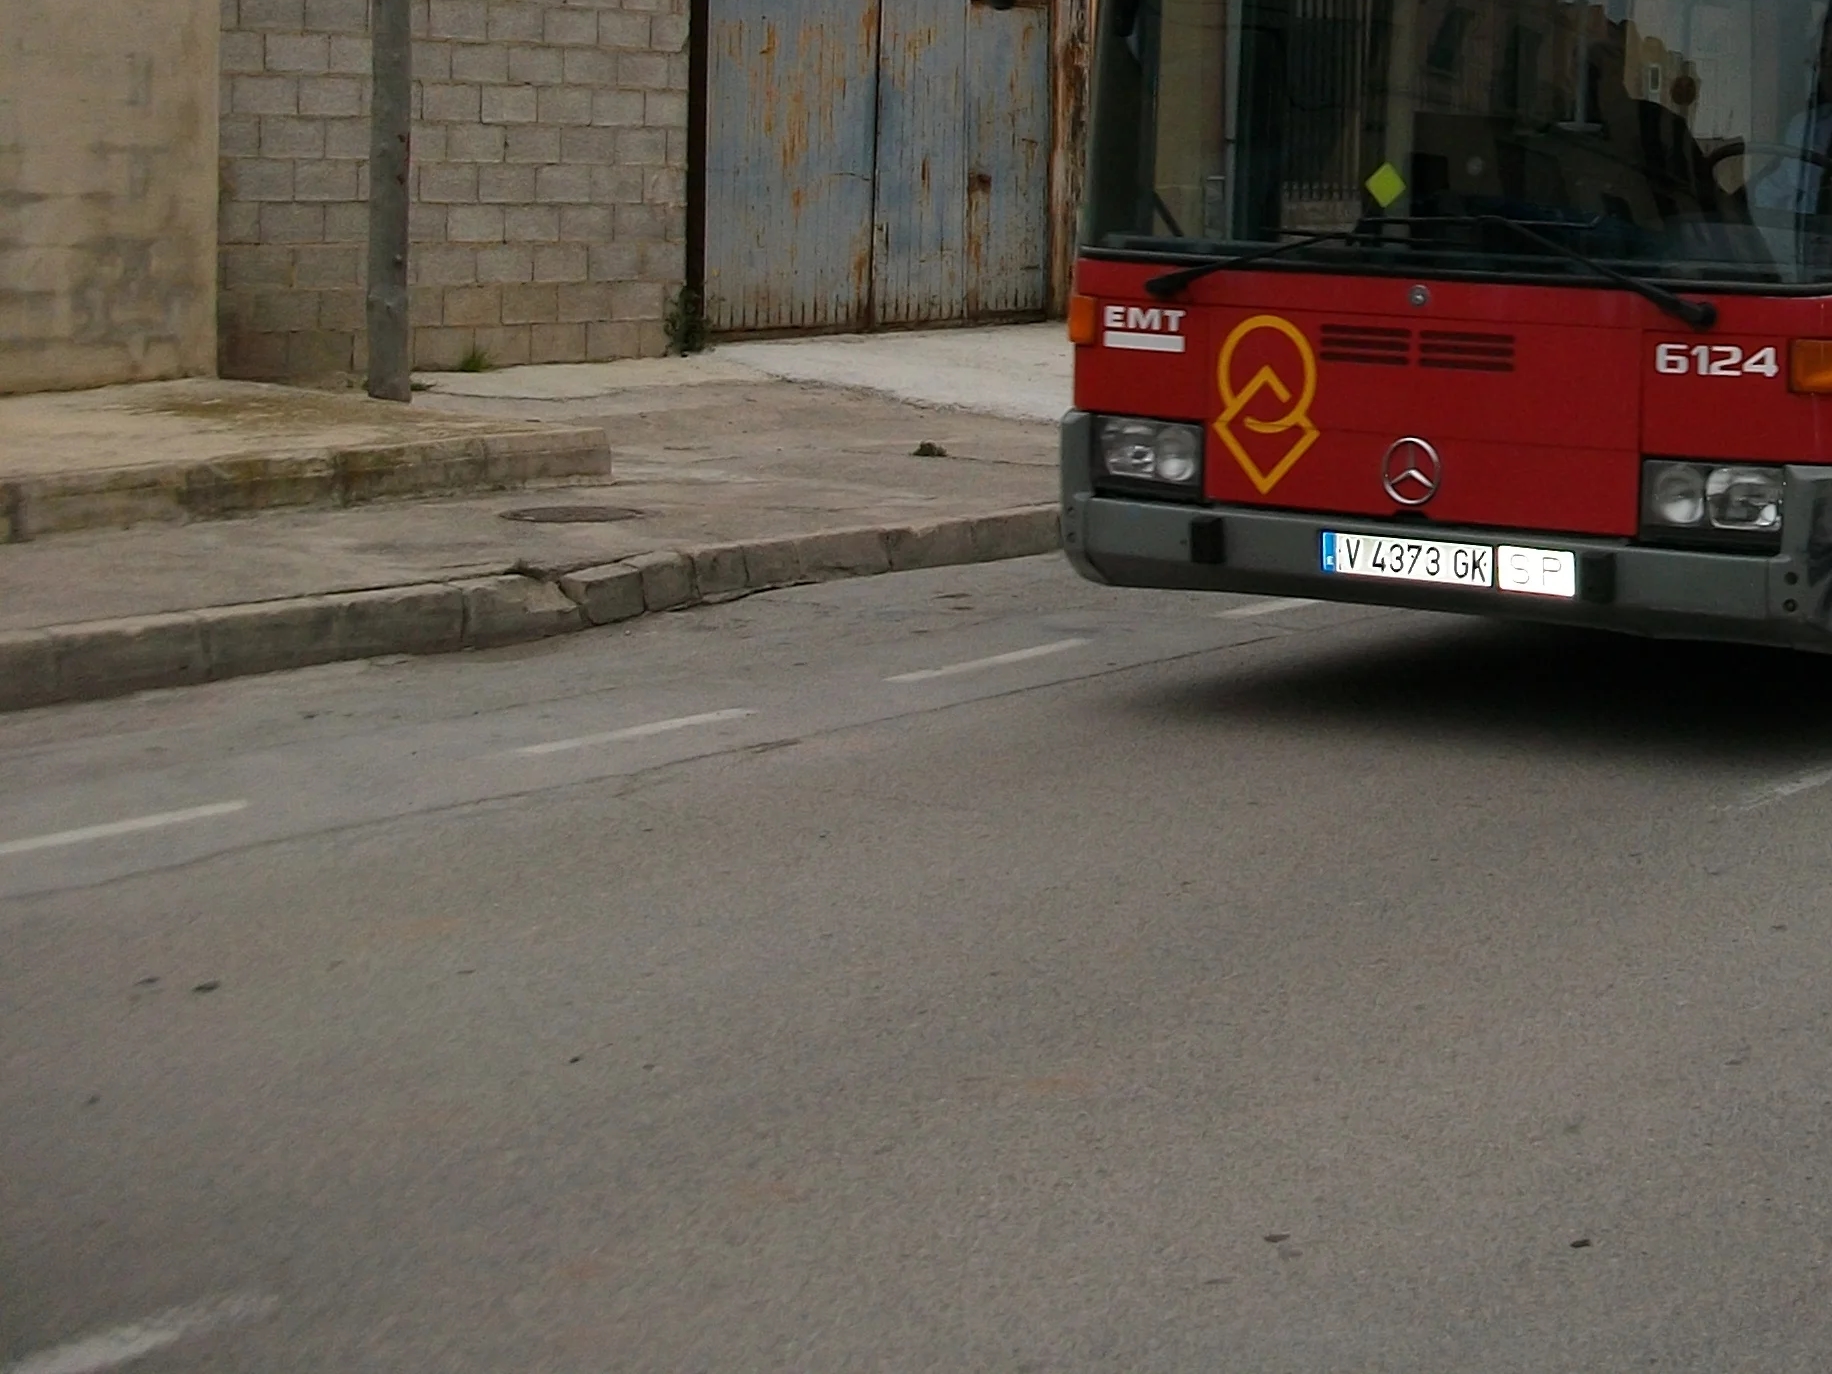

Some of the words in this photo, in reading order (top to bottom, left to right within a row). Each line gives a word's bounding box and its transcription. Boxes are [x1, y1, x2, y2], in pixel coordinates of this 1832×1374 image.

[1104, 305, 1187, 332] EMT
[1655, 343, 1779, 377] 6124
[1345, 537, 1361, 570] V
[1371, 540, 1441, 577] 4373
[1452, 548, 1487, 583] GK
